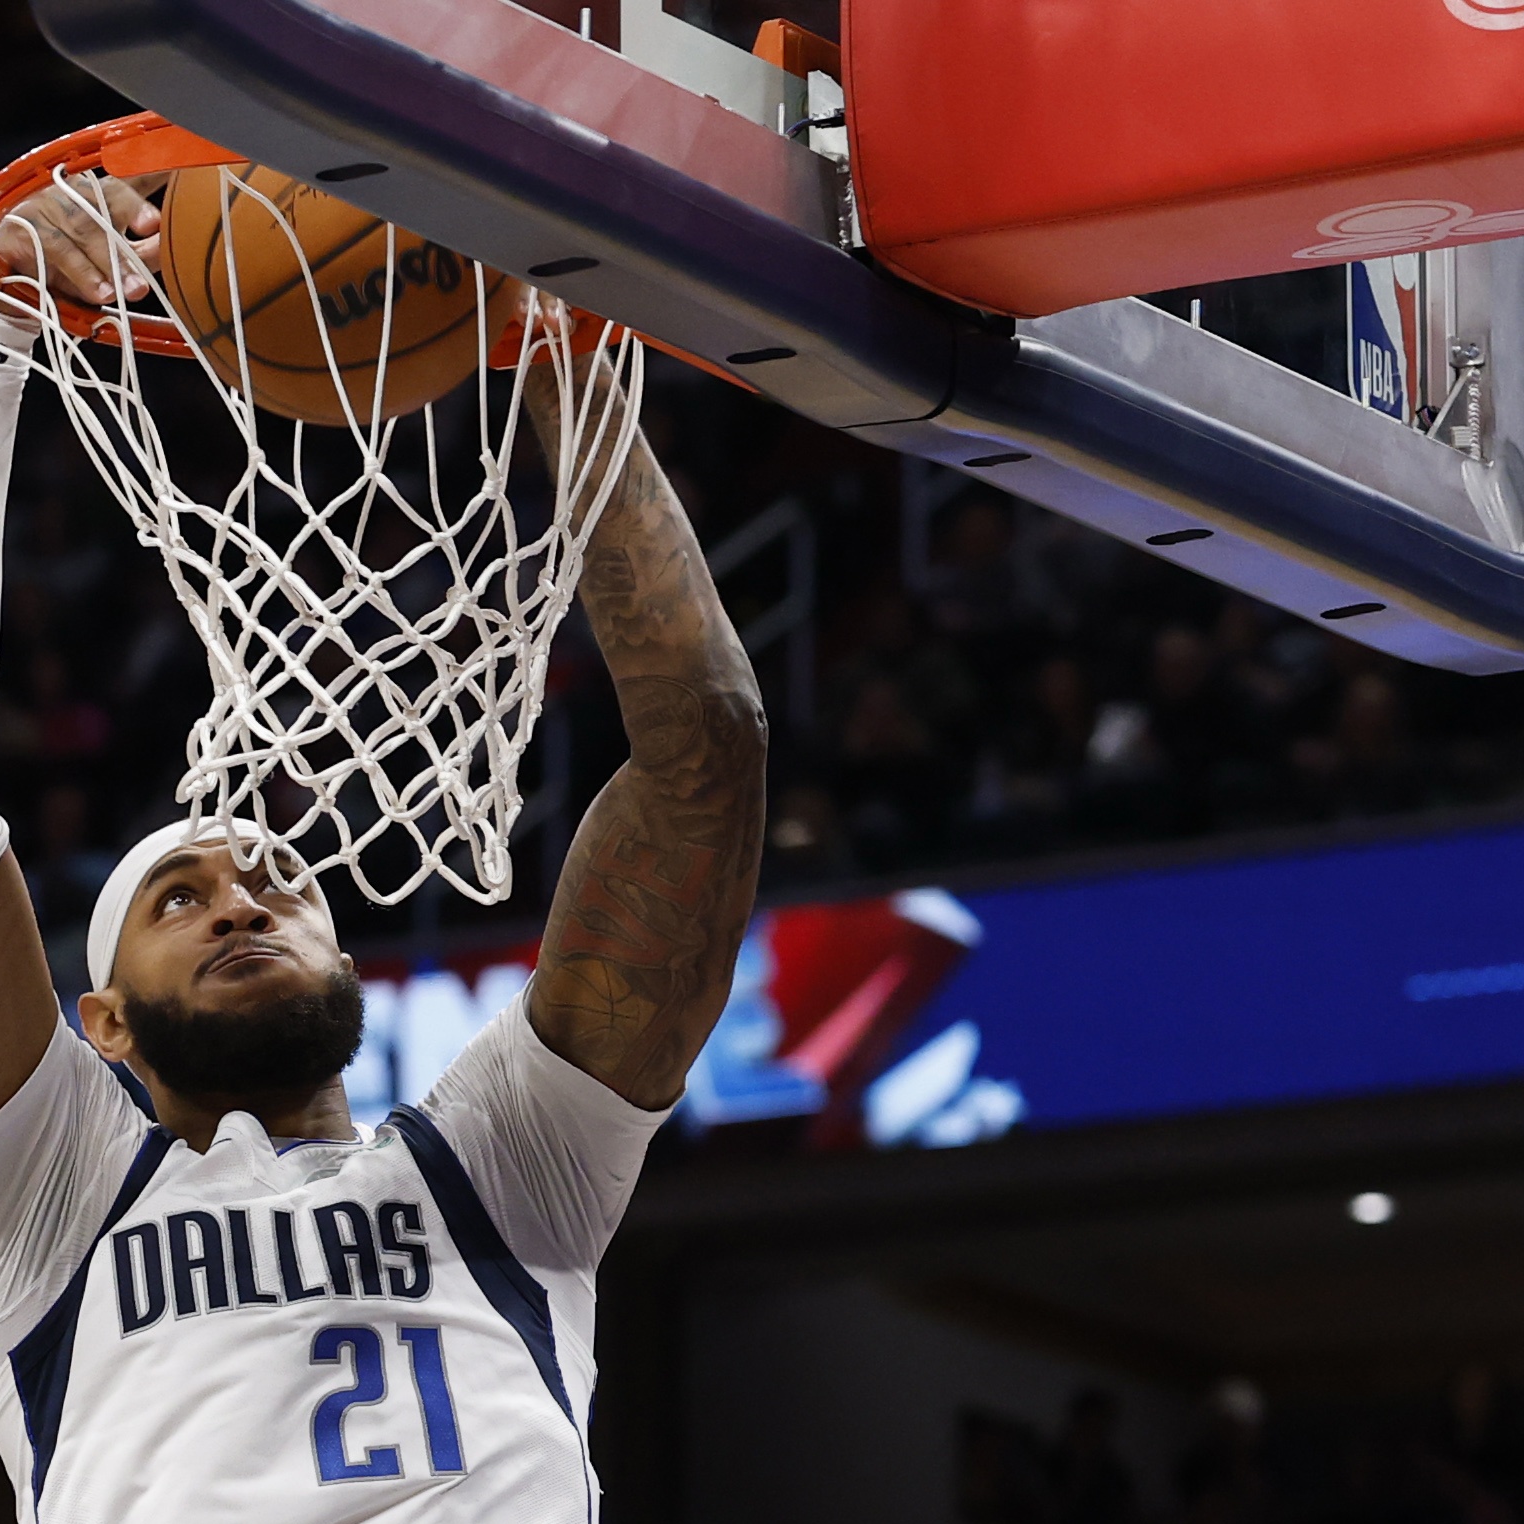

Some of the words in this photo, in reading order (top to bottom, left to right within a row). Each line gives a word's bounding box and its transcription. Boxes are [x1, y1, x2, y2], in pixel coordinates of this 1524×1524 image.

[1359, 338, 1396, 406] NBA
[110, 1199, 432, 1339] DALLAS
[309, 1323, 468, 1487] 21
